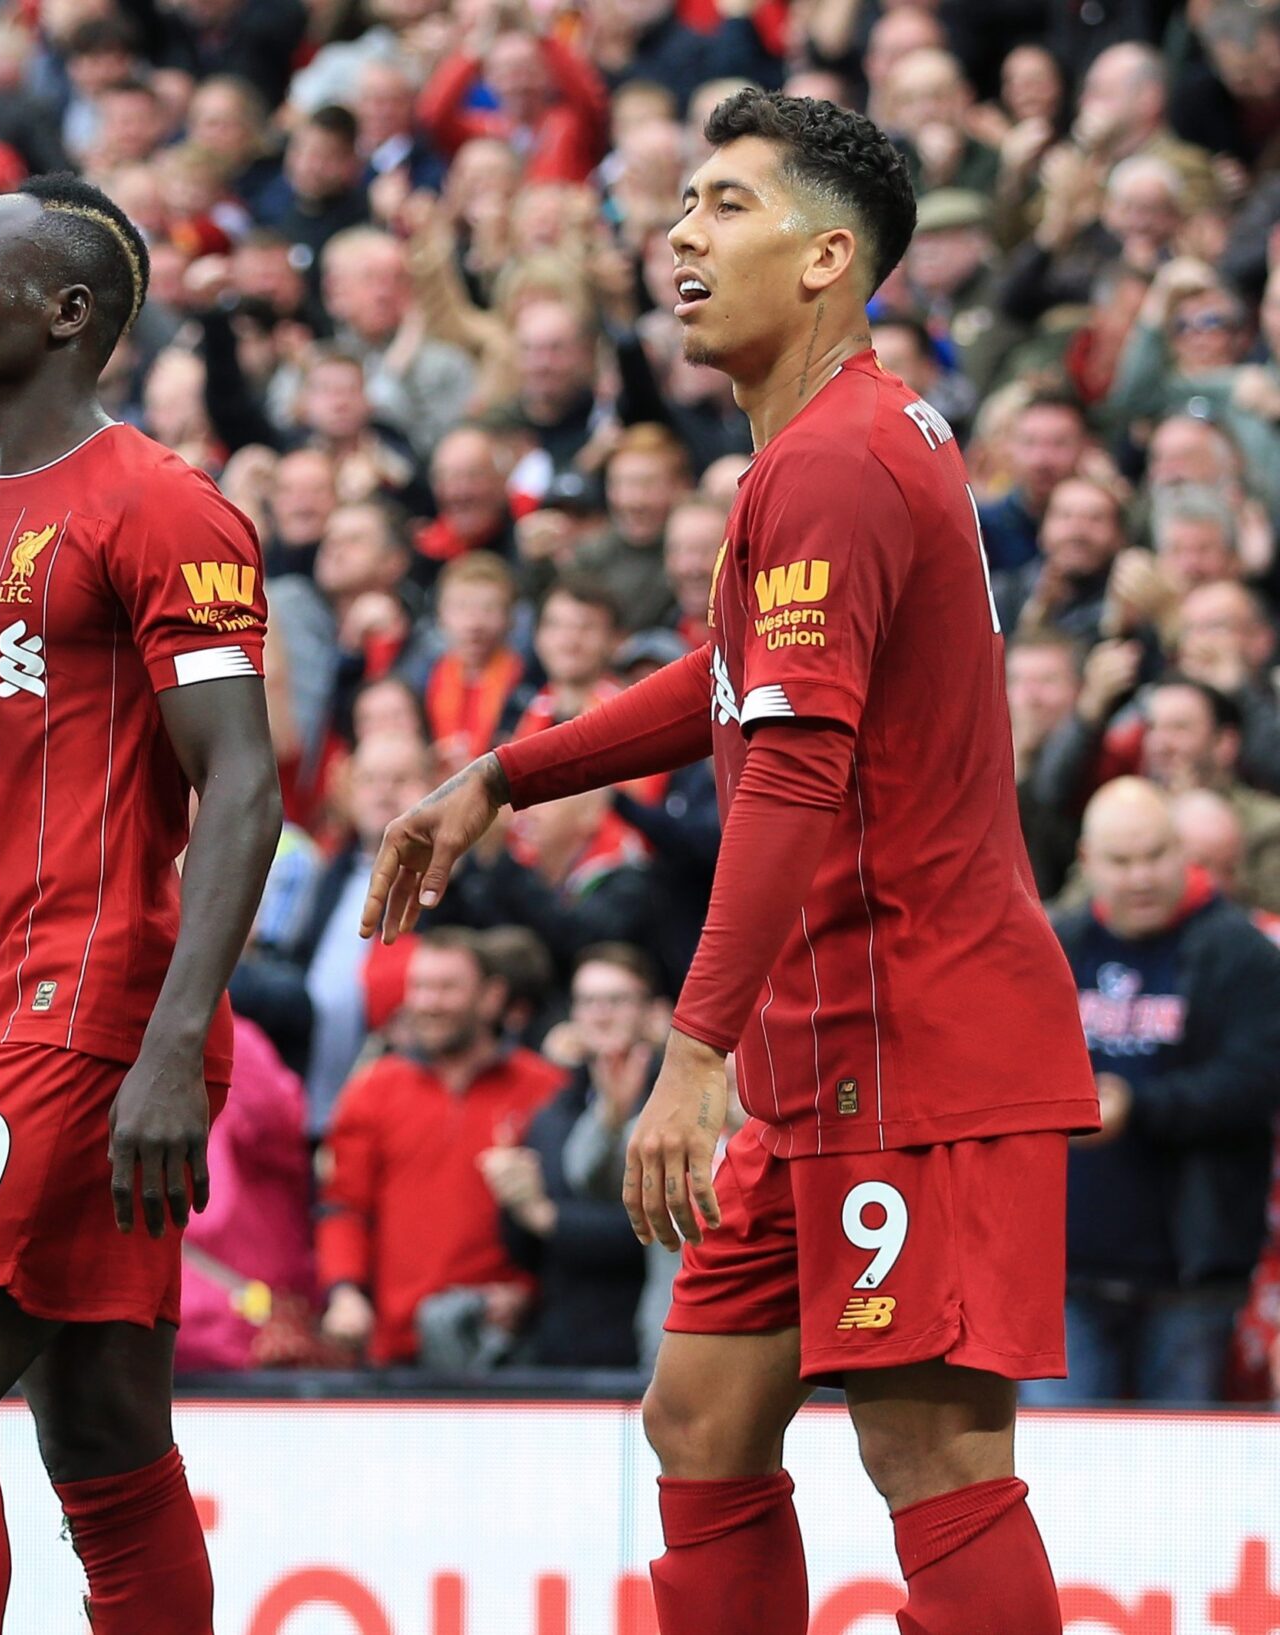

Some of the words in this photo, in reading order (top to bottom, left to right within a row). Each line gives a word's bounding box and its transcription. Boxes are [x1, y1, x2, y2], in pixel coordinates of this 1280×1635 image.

[180, 561, 256, 607] WU
[754, 560, 830, 614] WU
[754, 609, 825, 637] Western
[767, 625, 825, 651] Union
[841, 1180, 909, 1290] 9
